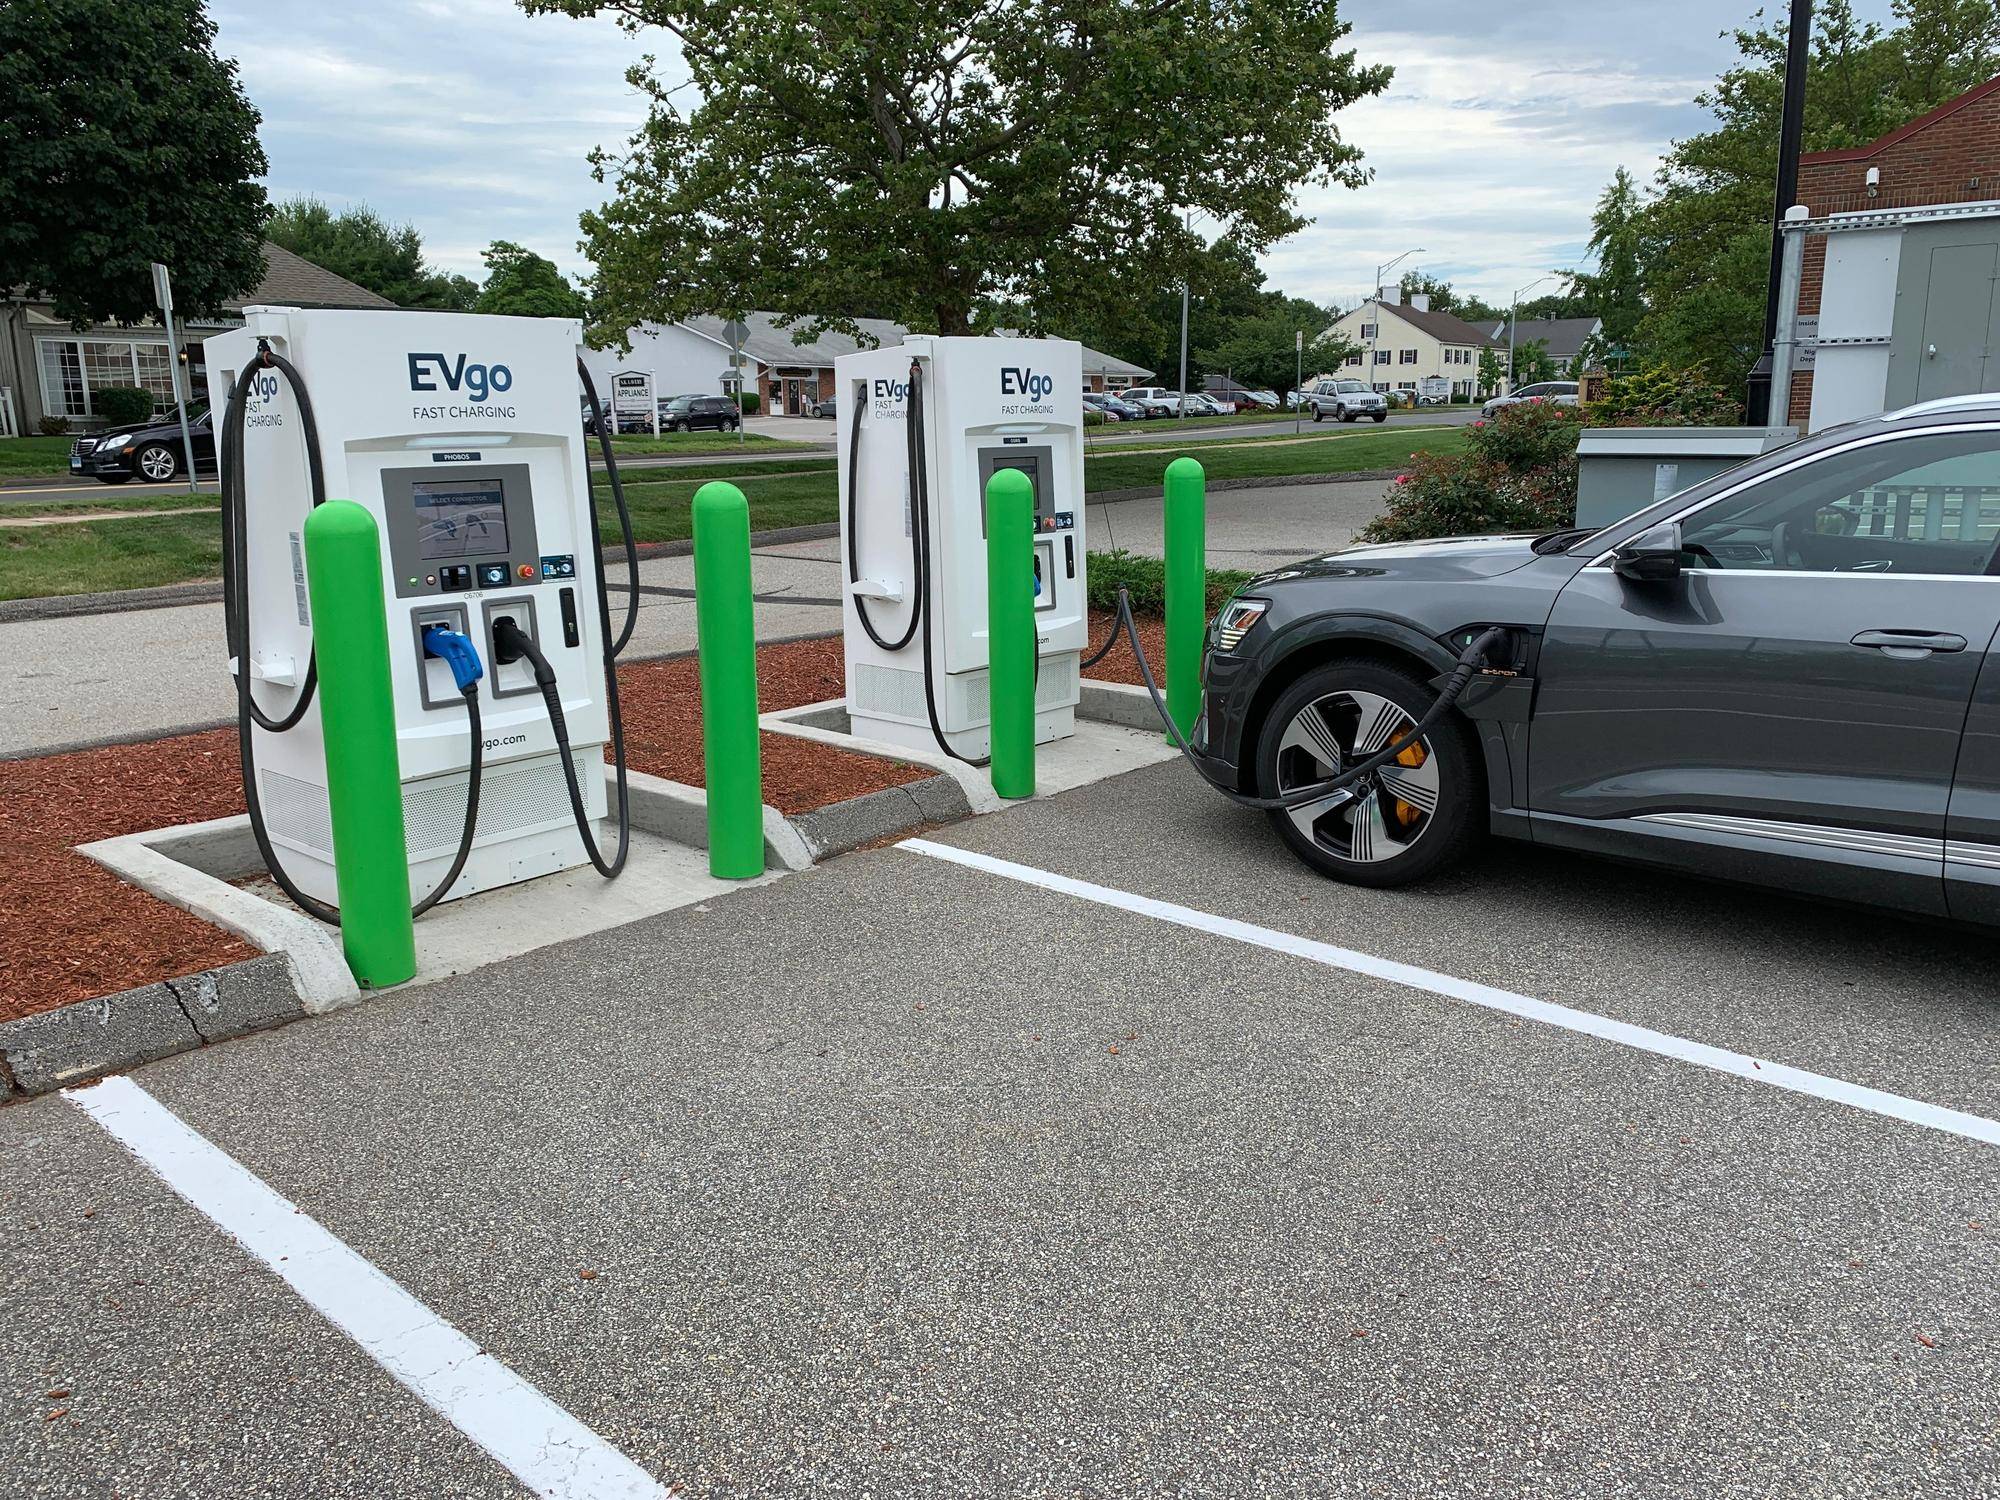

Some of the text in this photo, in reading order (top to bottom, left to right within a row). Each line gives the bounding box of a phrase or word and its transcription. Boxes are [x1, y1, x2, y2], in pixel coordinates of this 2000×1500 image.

[408, 353, 512, 402] EVgo
[875, 379, 909, 403] EVgo
[1001, 367, 1053, 403] EVgo
[617, 388, 649, 397] APPLIANCE
[875, 400, 892, 409] FAST
[1001, 405, 1053, 414] FAST CHARGING
[413, 406, 516, 419] FAST CHARGING
[875, 410, 907, 420] CHARGIN
[247, 414, 283, 428] CHARGING
[444, 453, 470, 461] PHOBOS
[480, 734, 526, 751] vgo.com
